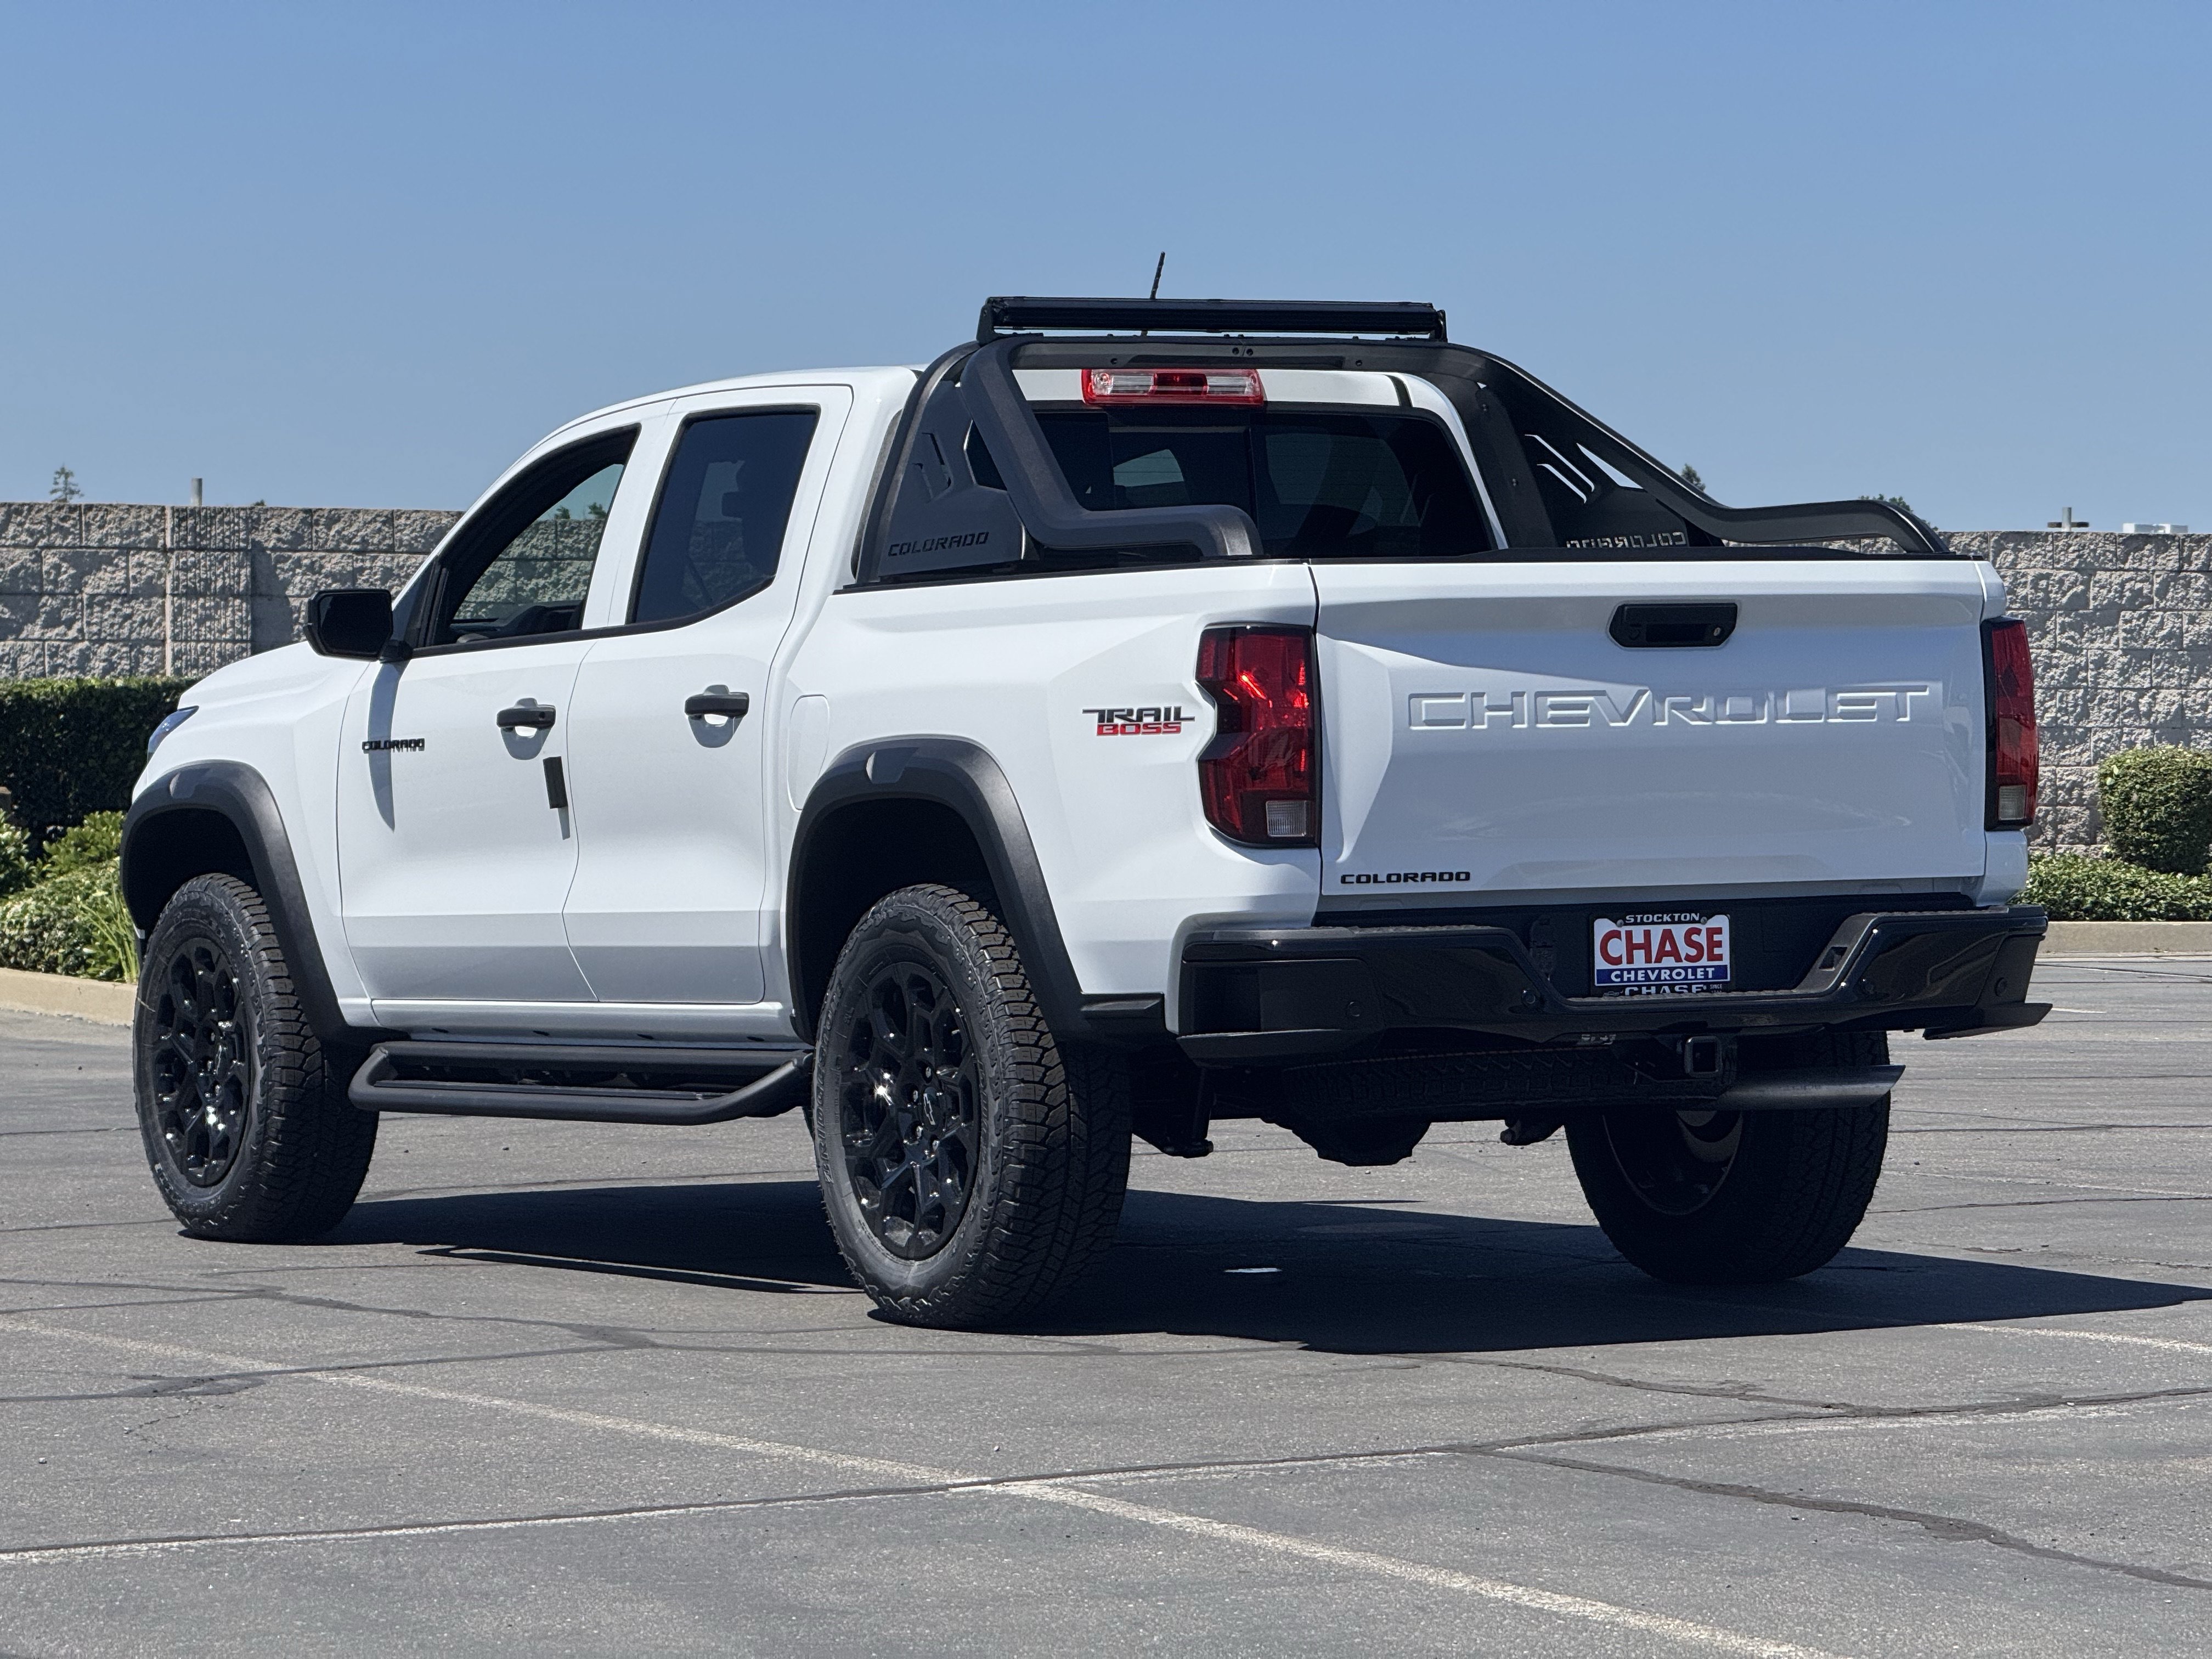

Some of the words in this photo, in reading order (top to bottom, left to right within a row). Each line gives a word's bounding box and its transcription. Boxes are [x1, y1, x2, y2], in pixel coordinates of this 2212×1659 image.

[888, 532, 989, 557] COLORADO
[1082, 706, 1195, 723] TRAIL
[1408, 686, 1928, 729] CHEVROLET
[1097, 722, 1182, 736] BOSS
[362, 738, 425, 749] COLORADO
[1340, 872, 1470, 884] COLORADO
[1626, 912, 1700, 923] STOCKTON
[1600, 927, 1723, 966] CHASE
[1611, 968, 1715, 982] CHEVROLET
